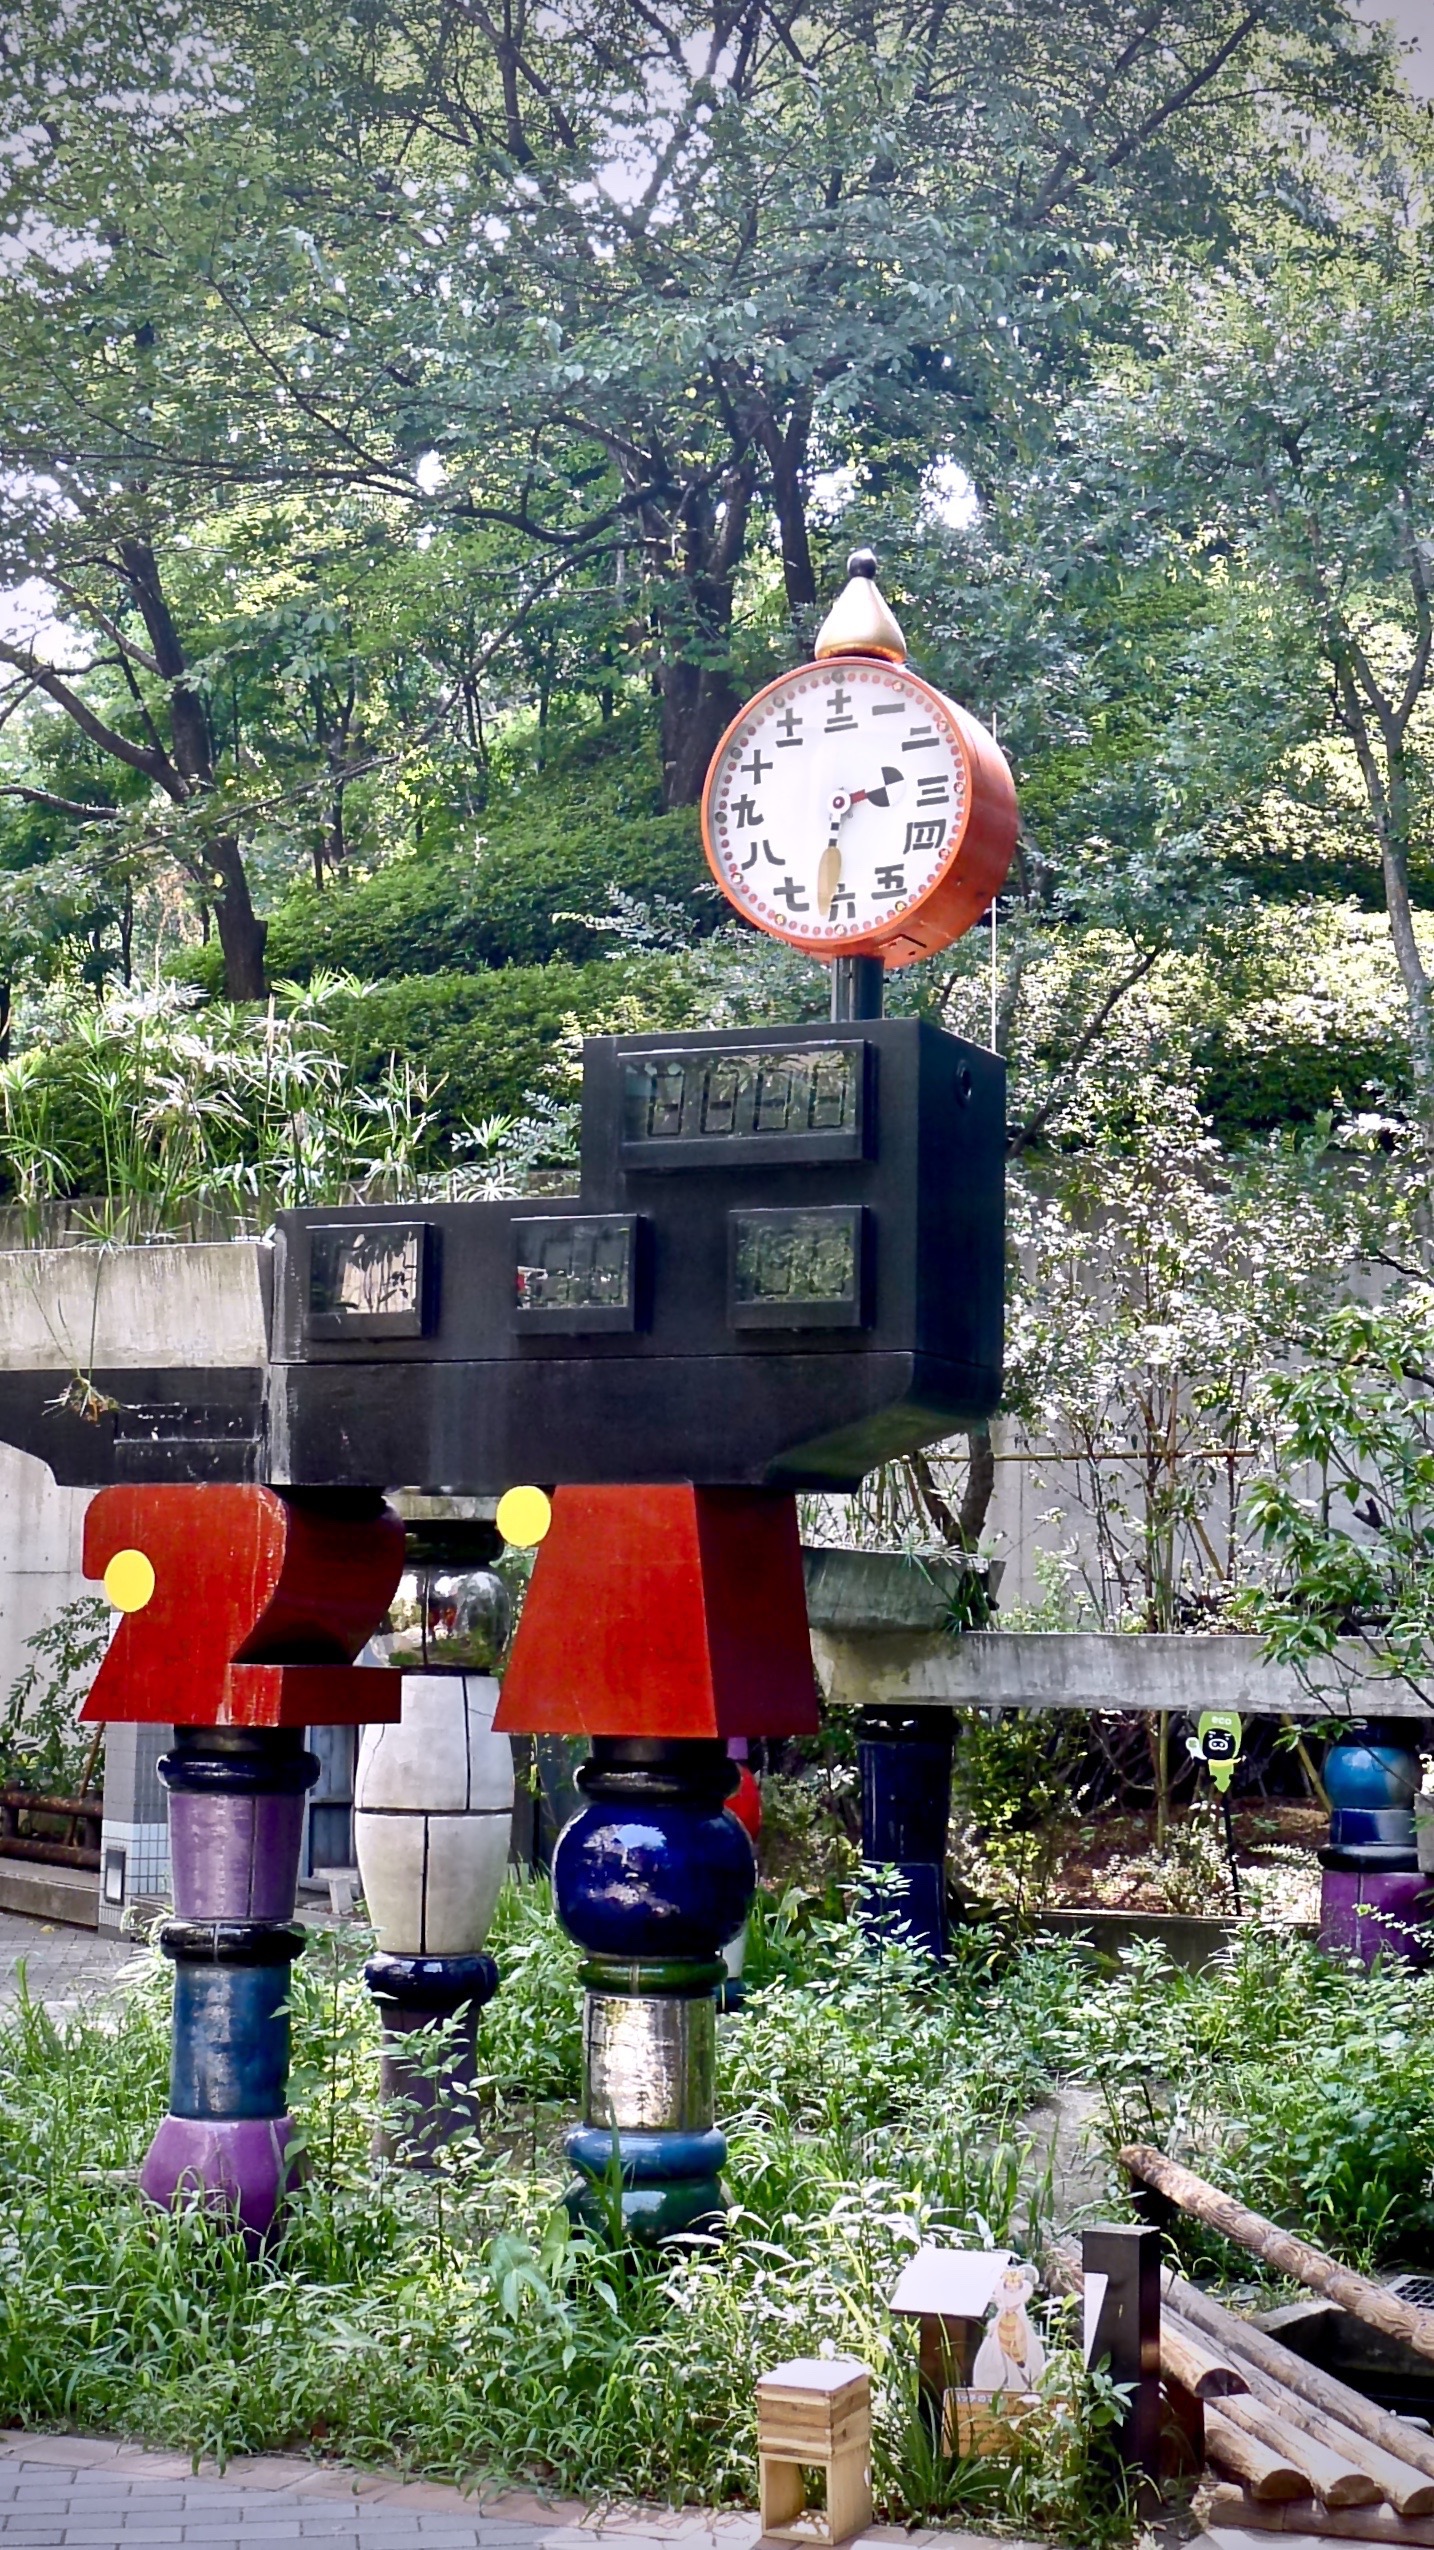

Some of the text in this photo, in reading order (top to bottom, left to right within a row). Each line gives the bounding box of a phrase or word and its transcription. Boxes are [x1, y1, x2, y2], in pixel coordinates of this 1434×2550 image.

[775, 707, 803, 748] 十一
[824, 688, 859, 733] 十二
[901, 725, 940, 751] 二
[740, 749, 773, 785] 十
[916, 775, 949, 807] 三
[731, 794, 764, 828] 九
[902, 818, 947, 855] 四
[741, 839, 786, 871] 八
[773, 876, 809, 912] 七
[871, 863, 908, 900] 五
[828, 882, 856, 922] 六
[1211, 1716, 1232, 1725] eco
